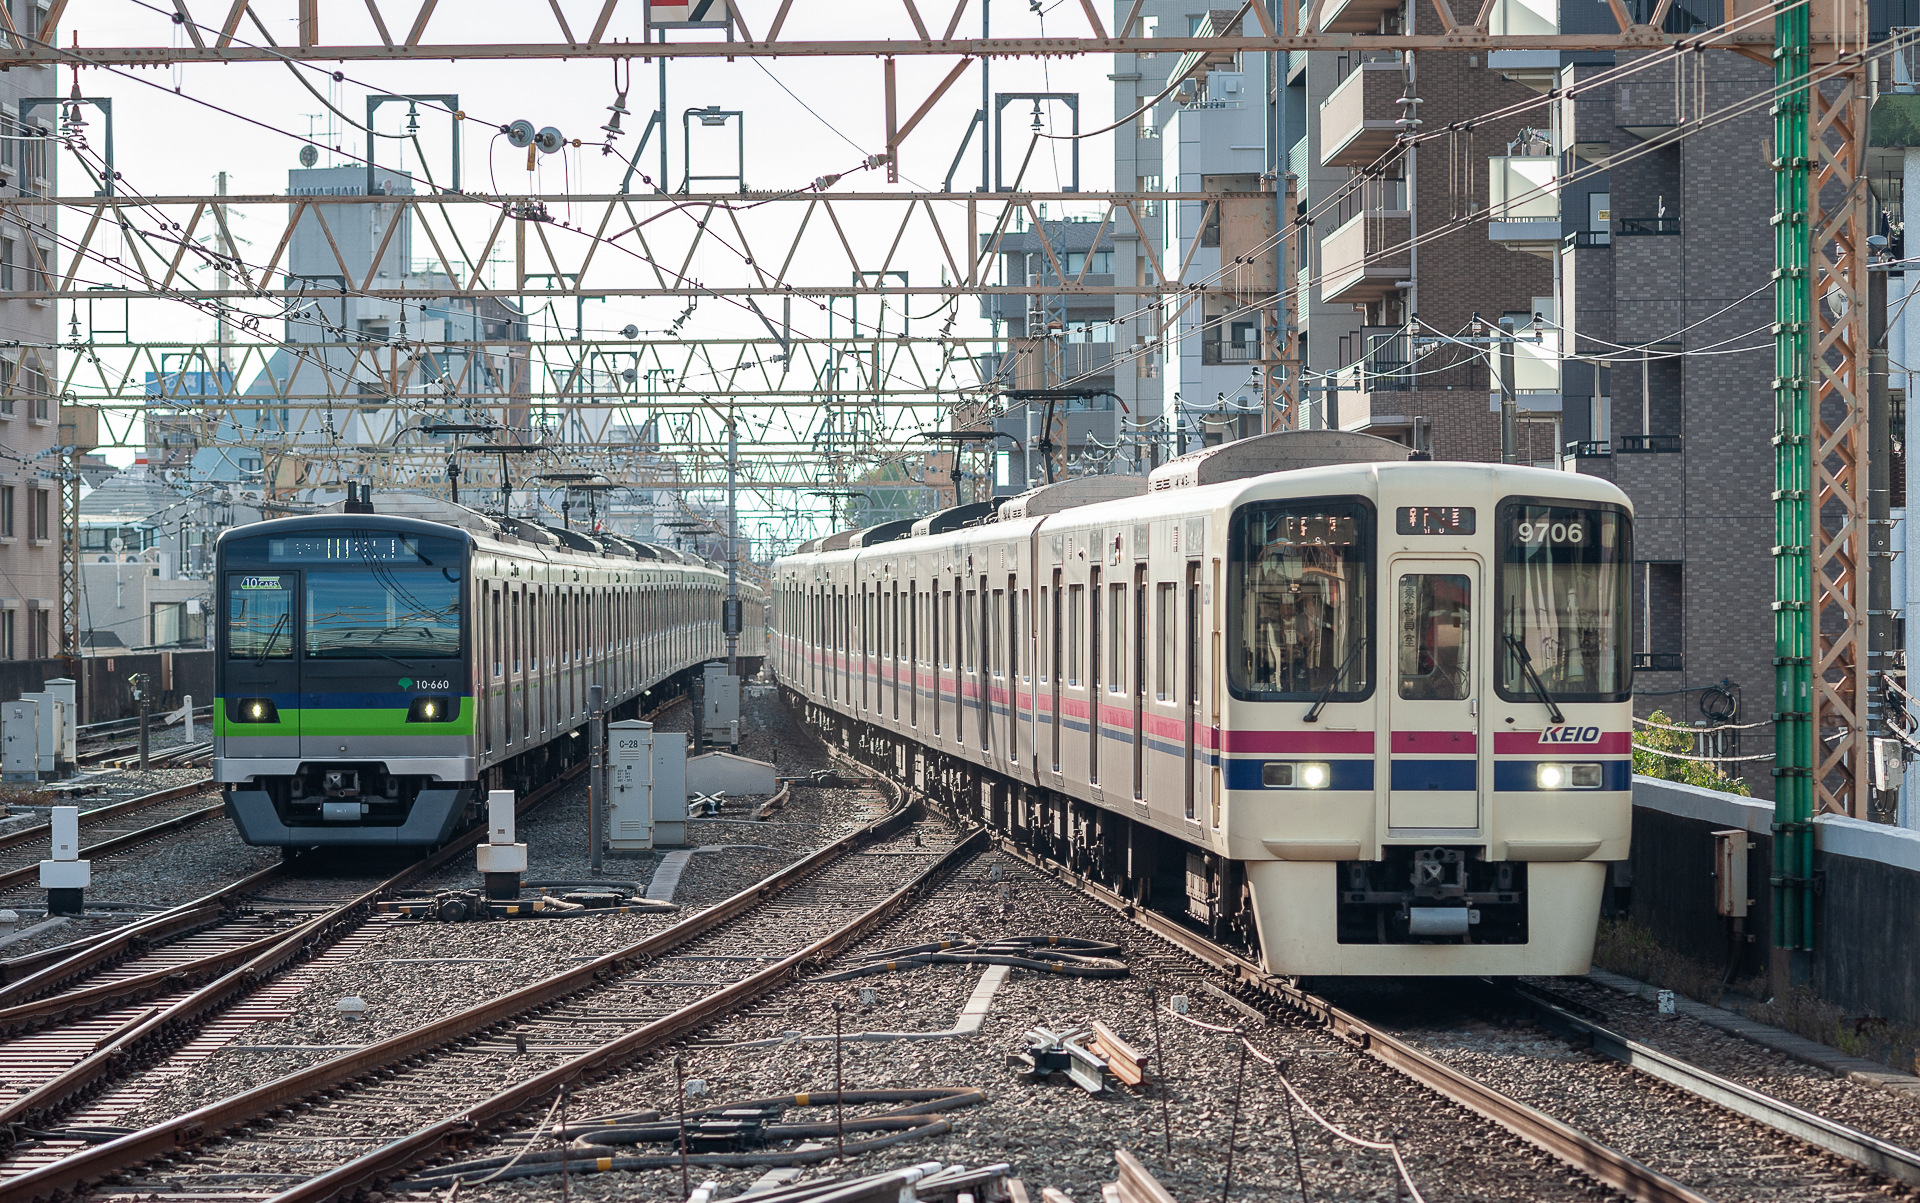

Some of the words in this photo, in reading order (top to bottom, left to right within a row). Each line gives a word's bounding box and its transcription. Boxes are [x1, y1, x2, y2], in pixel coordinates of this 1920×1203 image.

[1518, 523, 1583, 543] 9706
[246, 578, 258, 588] 10
[416, 680, 449, 689] 10-660
[1541, 726, 1600, 742] KEIO
[619, 739, 638, 748] C-28
